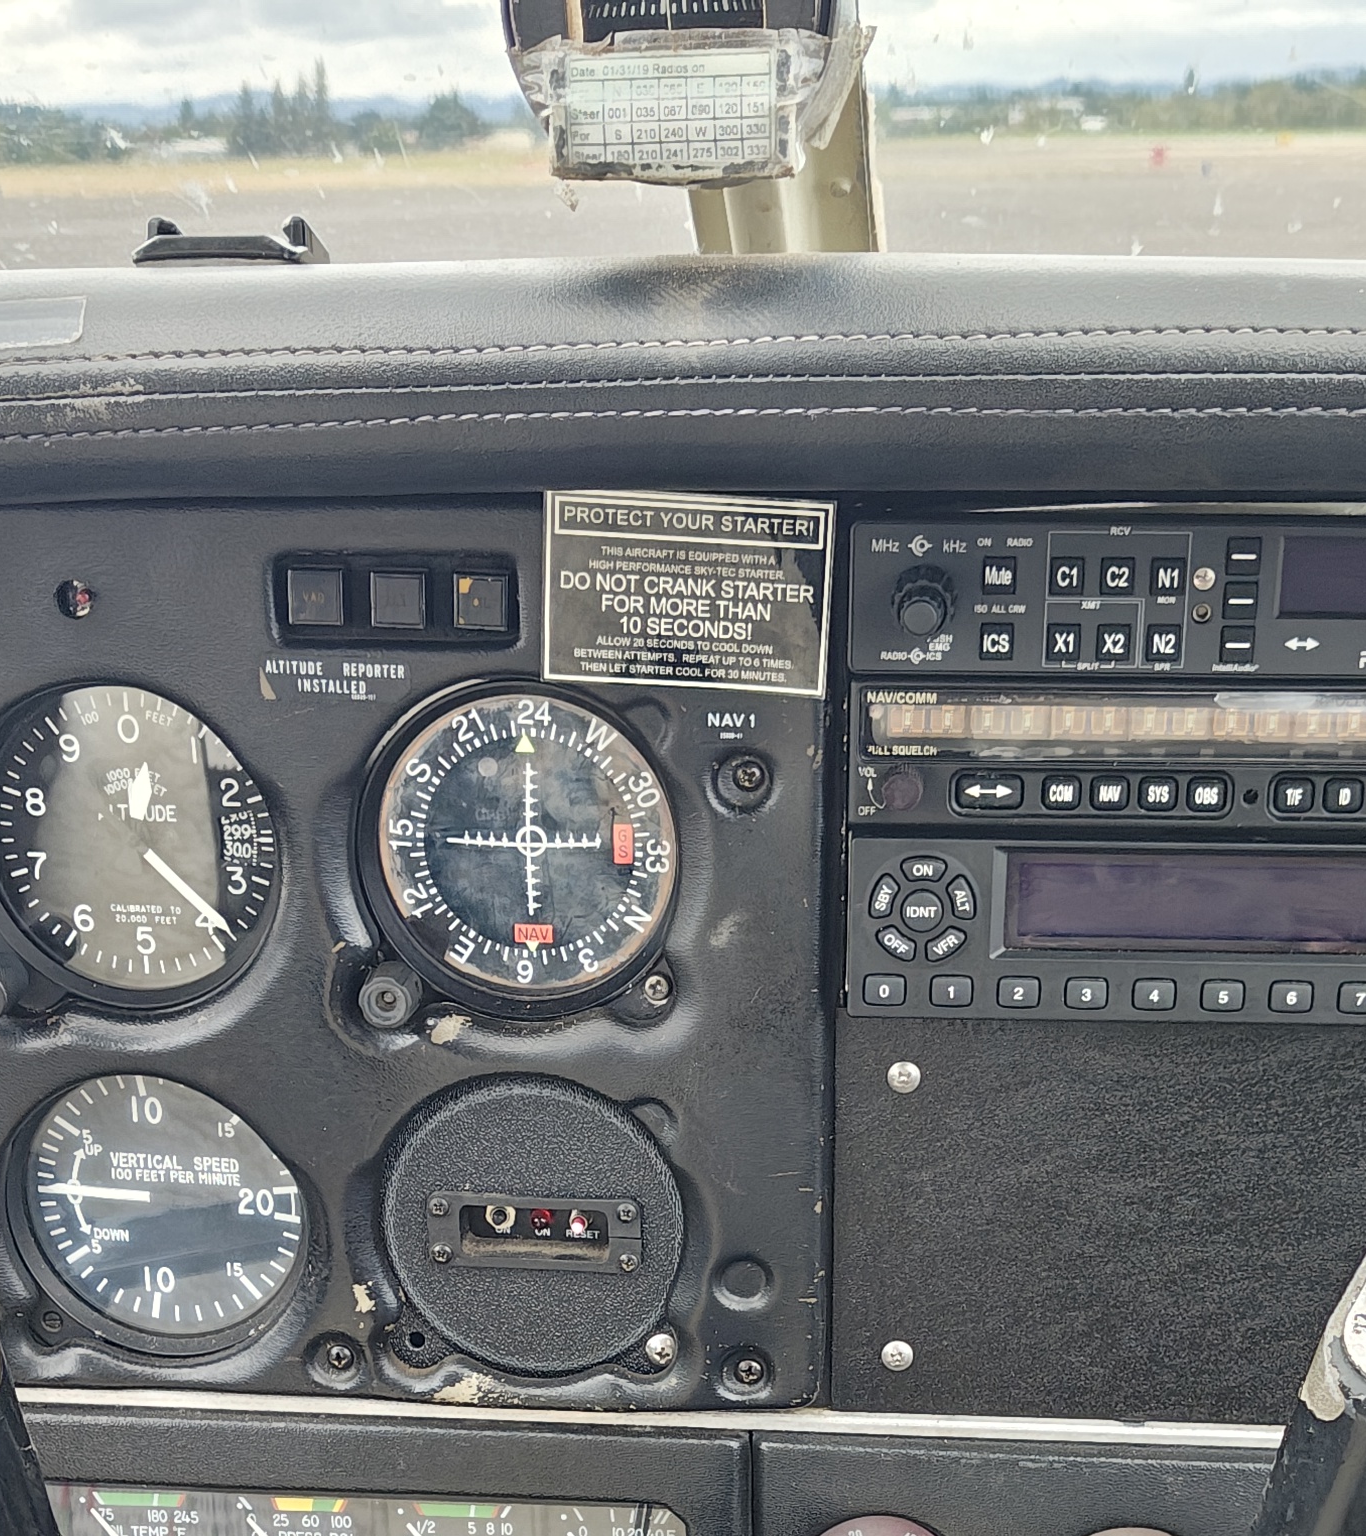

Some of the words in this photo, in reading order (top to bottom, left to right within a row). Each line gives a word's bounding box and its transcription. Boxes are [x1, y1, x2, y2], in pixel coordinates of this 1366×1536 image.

[636, 128, 657, 140] 210
[663, 126, 684, 139] 240
[694, 126, 708, 138] W
[563, 505, 655, 527] PROTECT
[659, 511, 714, 531] YOUR
[720, 515, 814, 537] STARTER!
[871, 538, 900, 553] MHz
[942, 539, 967, 553] kHz
[985, 565, 1013, 586] Mute
[1056, 566, 1078, 588] C1
[1106, 566, 1129, 588] C2
[1158, 568, 1179, 589] N1
[559, 570, 591, 590] DO
[595, 572, 641, 594] NOT
[643, 576, 717, 598] CRANK
[720, 580, 814, 604] STARTER
[601, 593, 645, 614] FOR
[649, 596, 711, 618] MORE
[715, 600, 771, 622] THAN
[619, 615, 642, 635] 10
[646, 616, 753, 641] SECONDS!
[595, 634, 631, 647] ALLOW
[633, 637, 645, 648] 20
[646, 638, 695, 650] SECONDS
[696, 640, 711, 651] TO
[711, 642, 741, 653] COOL
[741, 643, 773, 655] DOWN
[983, 633, 1010, 653] ICS
[1053, 632, 1075, 653] X1
[1101, 632, 1125, 654] X2
[1152, 633, 1176, 654] N2
[265, 659, 323, 676] ALTITUDE
[342, 662, 405, 679] REPORTER
[296, 678, 366, 695] INSTALLED
[867, 690, 938, 704] NAV/COMM
[517, 698, 552, 727] 24
[707, 712, 745, 728] NAV
[749, 713, 755, 728] 1
[59, 733, 81, 763] 9
[1049, 784, 1074, 802] COM
[1099, 784, 1122, 802] NAV
[1147, 784, 1170, 803] SYS
[1194, 786, 1219, 805] OBS
[1285, 788, 1304, 806] T/F
[1338, 787, 1351, 806] ID
[645, 838, 671, 874] 33
[912, 864, 934, 877] ON
[906, 906, 938, 918] IDNT
[518, 927, 549, 941] NAV
[109, 1151, 183, 1170] VERTICAL
[193, 1156, 239, 1173] SPEED
[111, 1167, 133, 1181] 100
[135, 1168, 166, 1183] FEET
[169, 1169, 195, 1184] PER
[197, 1171, 241, 1187] MINUTE
[237, 1187, 275, 1216] 20
[93, 1226, 130, 1242] DOWN
[143, 1266, 176, 1294] 10
[147, 1509, 169, 1524] 180
[173, 1510, 199, 1525] 245
